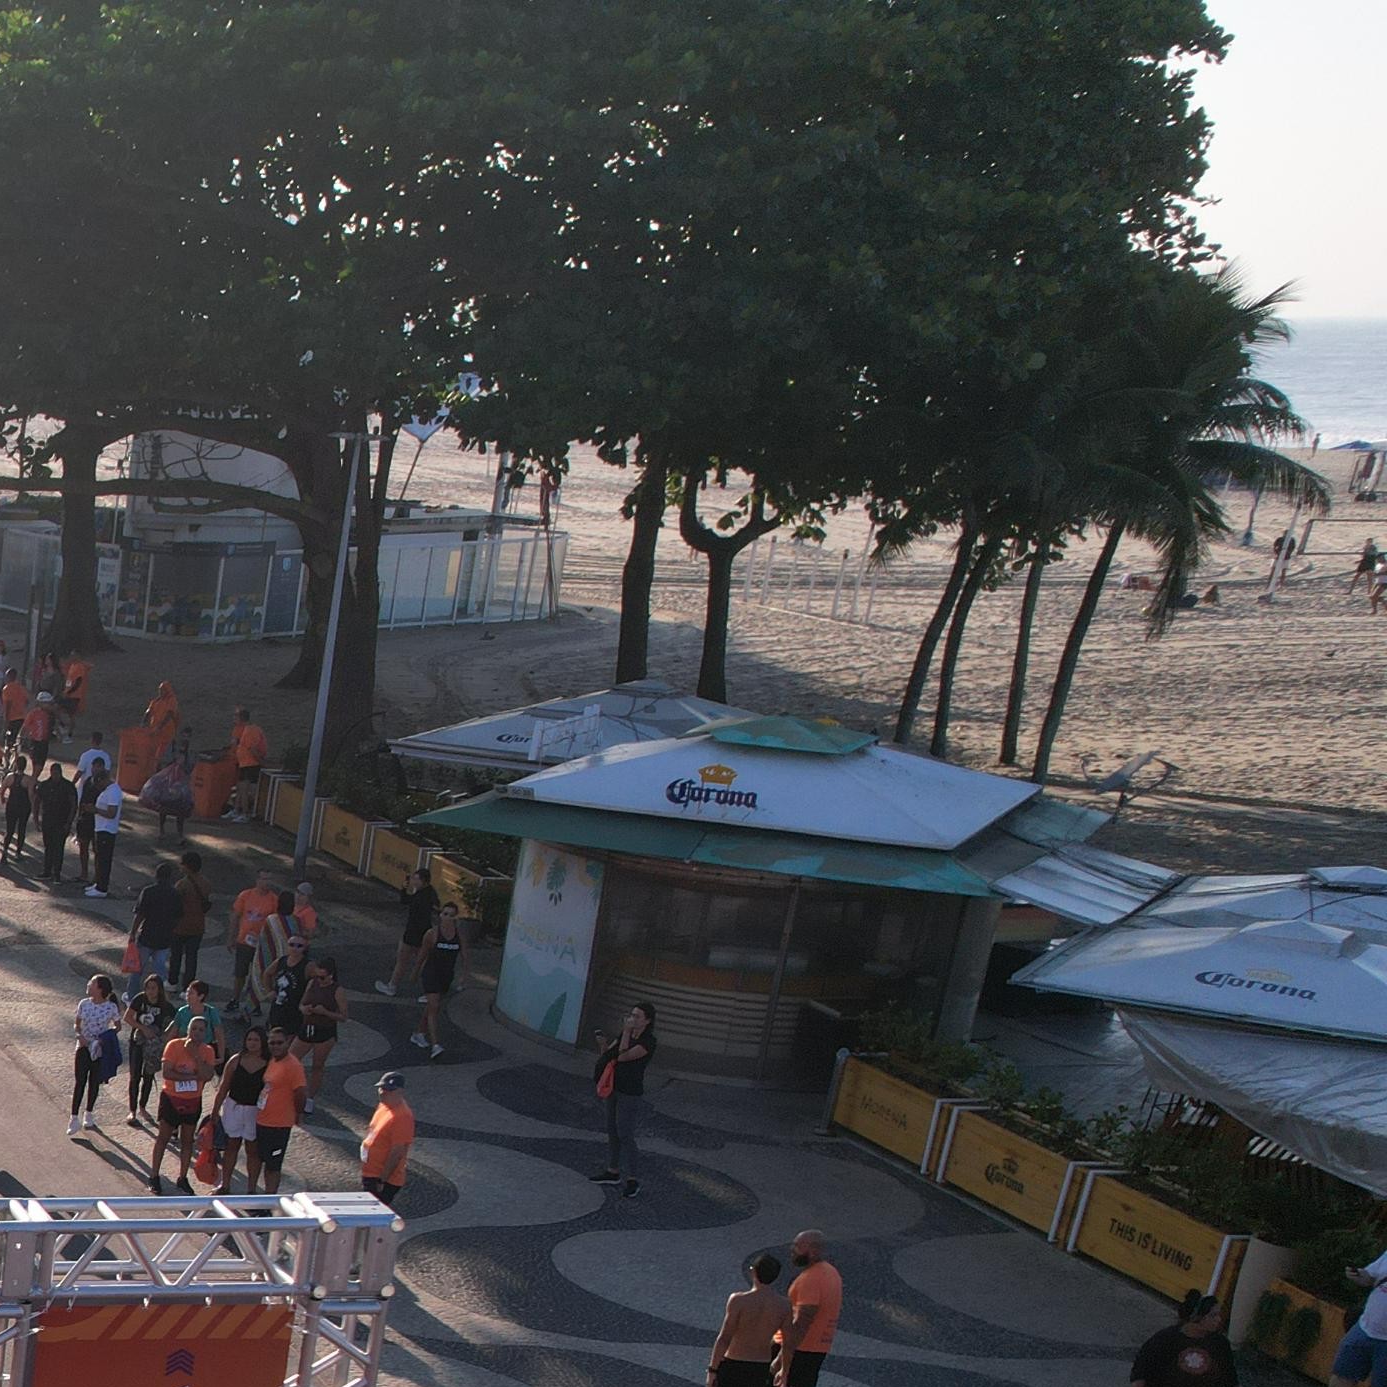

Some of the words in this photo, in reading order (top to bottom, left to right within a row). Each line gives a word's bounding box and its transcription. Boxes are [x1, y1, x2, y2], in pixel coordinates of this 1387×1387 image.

[666, 777, 758, 809] Corona
[1194, 970, 1317, 1001] Corona
[984, 1163, 1025, 1196] Corona
[1109, 1217, 1136, 1242] THIS
[1136, 1230, 1153, 1250] IS
[1149, 1236, 1193, 1272] LIVING
